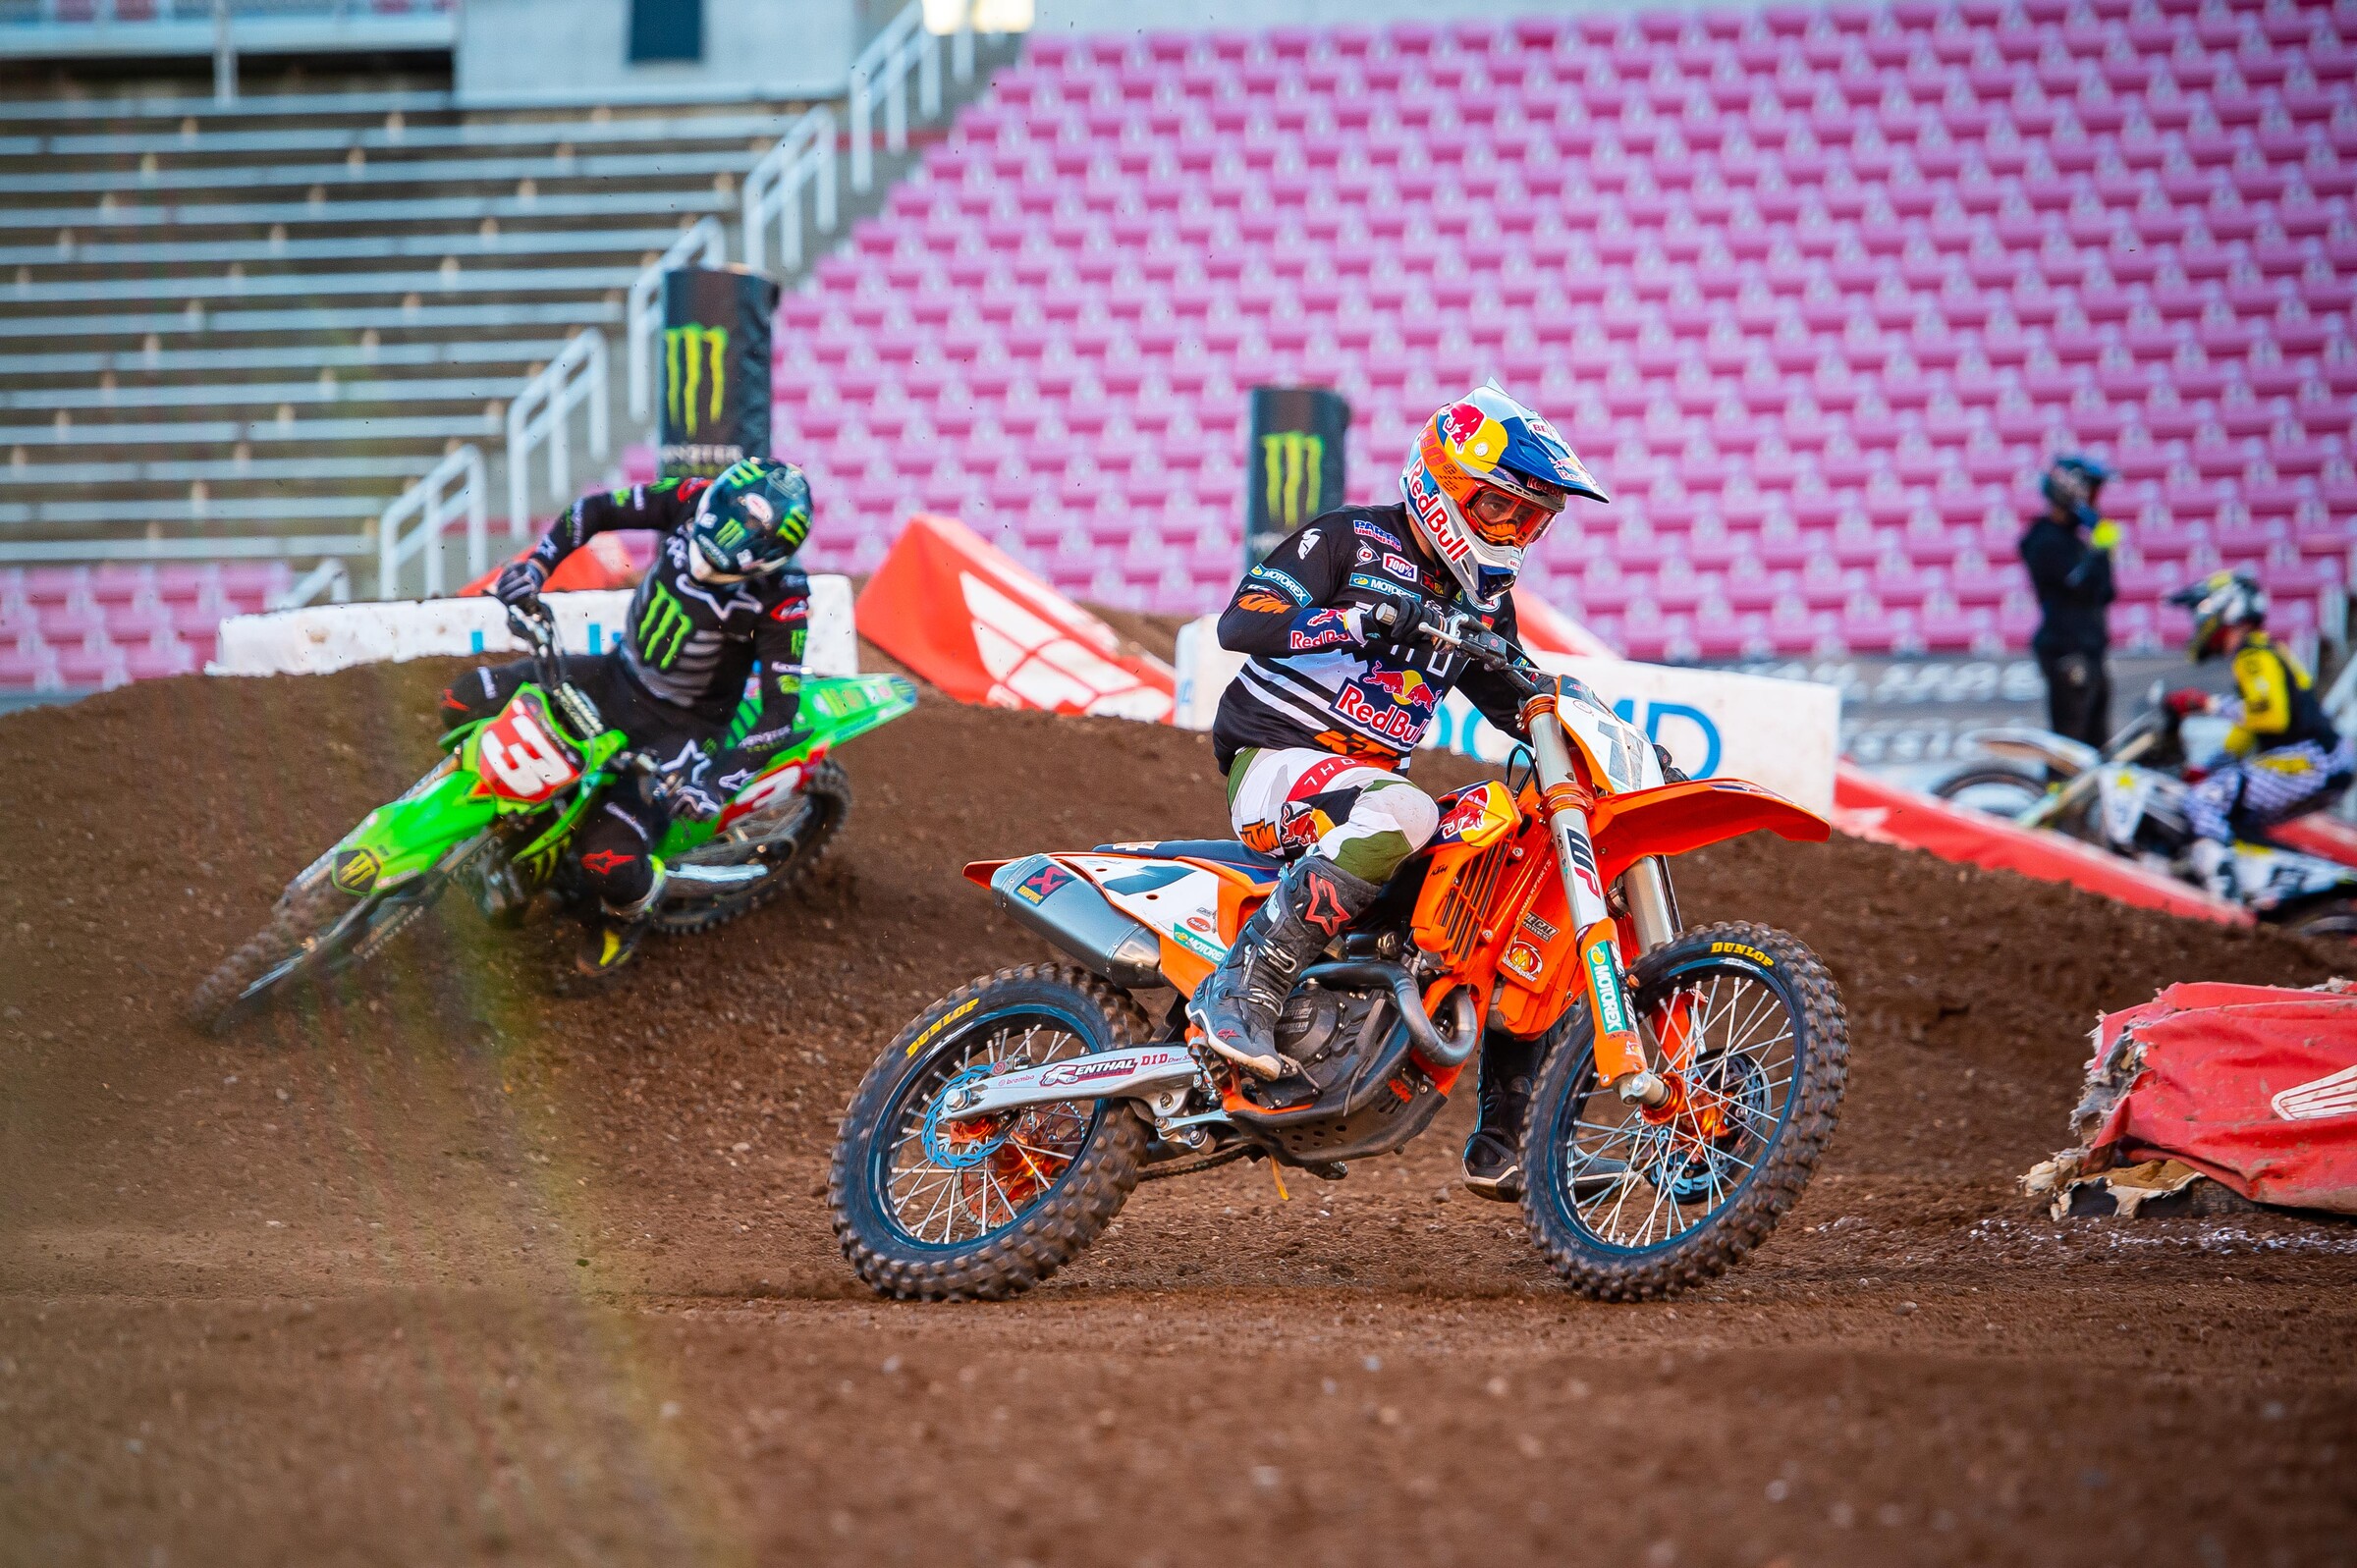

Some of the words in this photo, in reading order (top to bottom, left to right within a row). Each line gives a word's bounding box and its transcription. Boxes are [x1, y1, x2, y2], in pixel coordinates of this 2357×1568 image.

[1353, 520, 1401, 547] PARTS
[1387, 557, 1412, 577] 100%
[1262, 570, 1308, 602] MOTOREX
[480, 715, 573, 797] 3
[1429, 864, 1449, 877] KTM
[1710, 941, 1775, 967] DUNLOP
[1594, 964, 1623, 1032] MOTOREX
